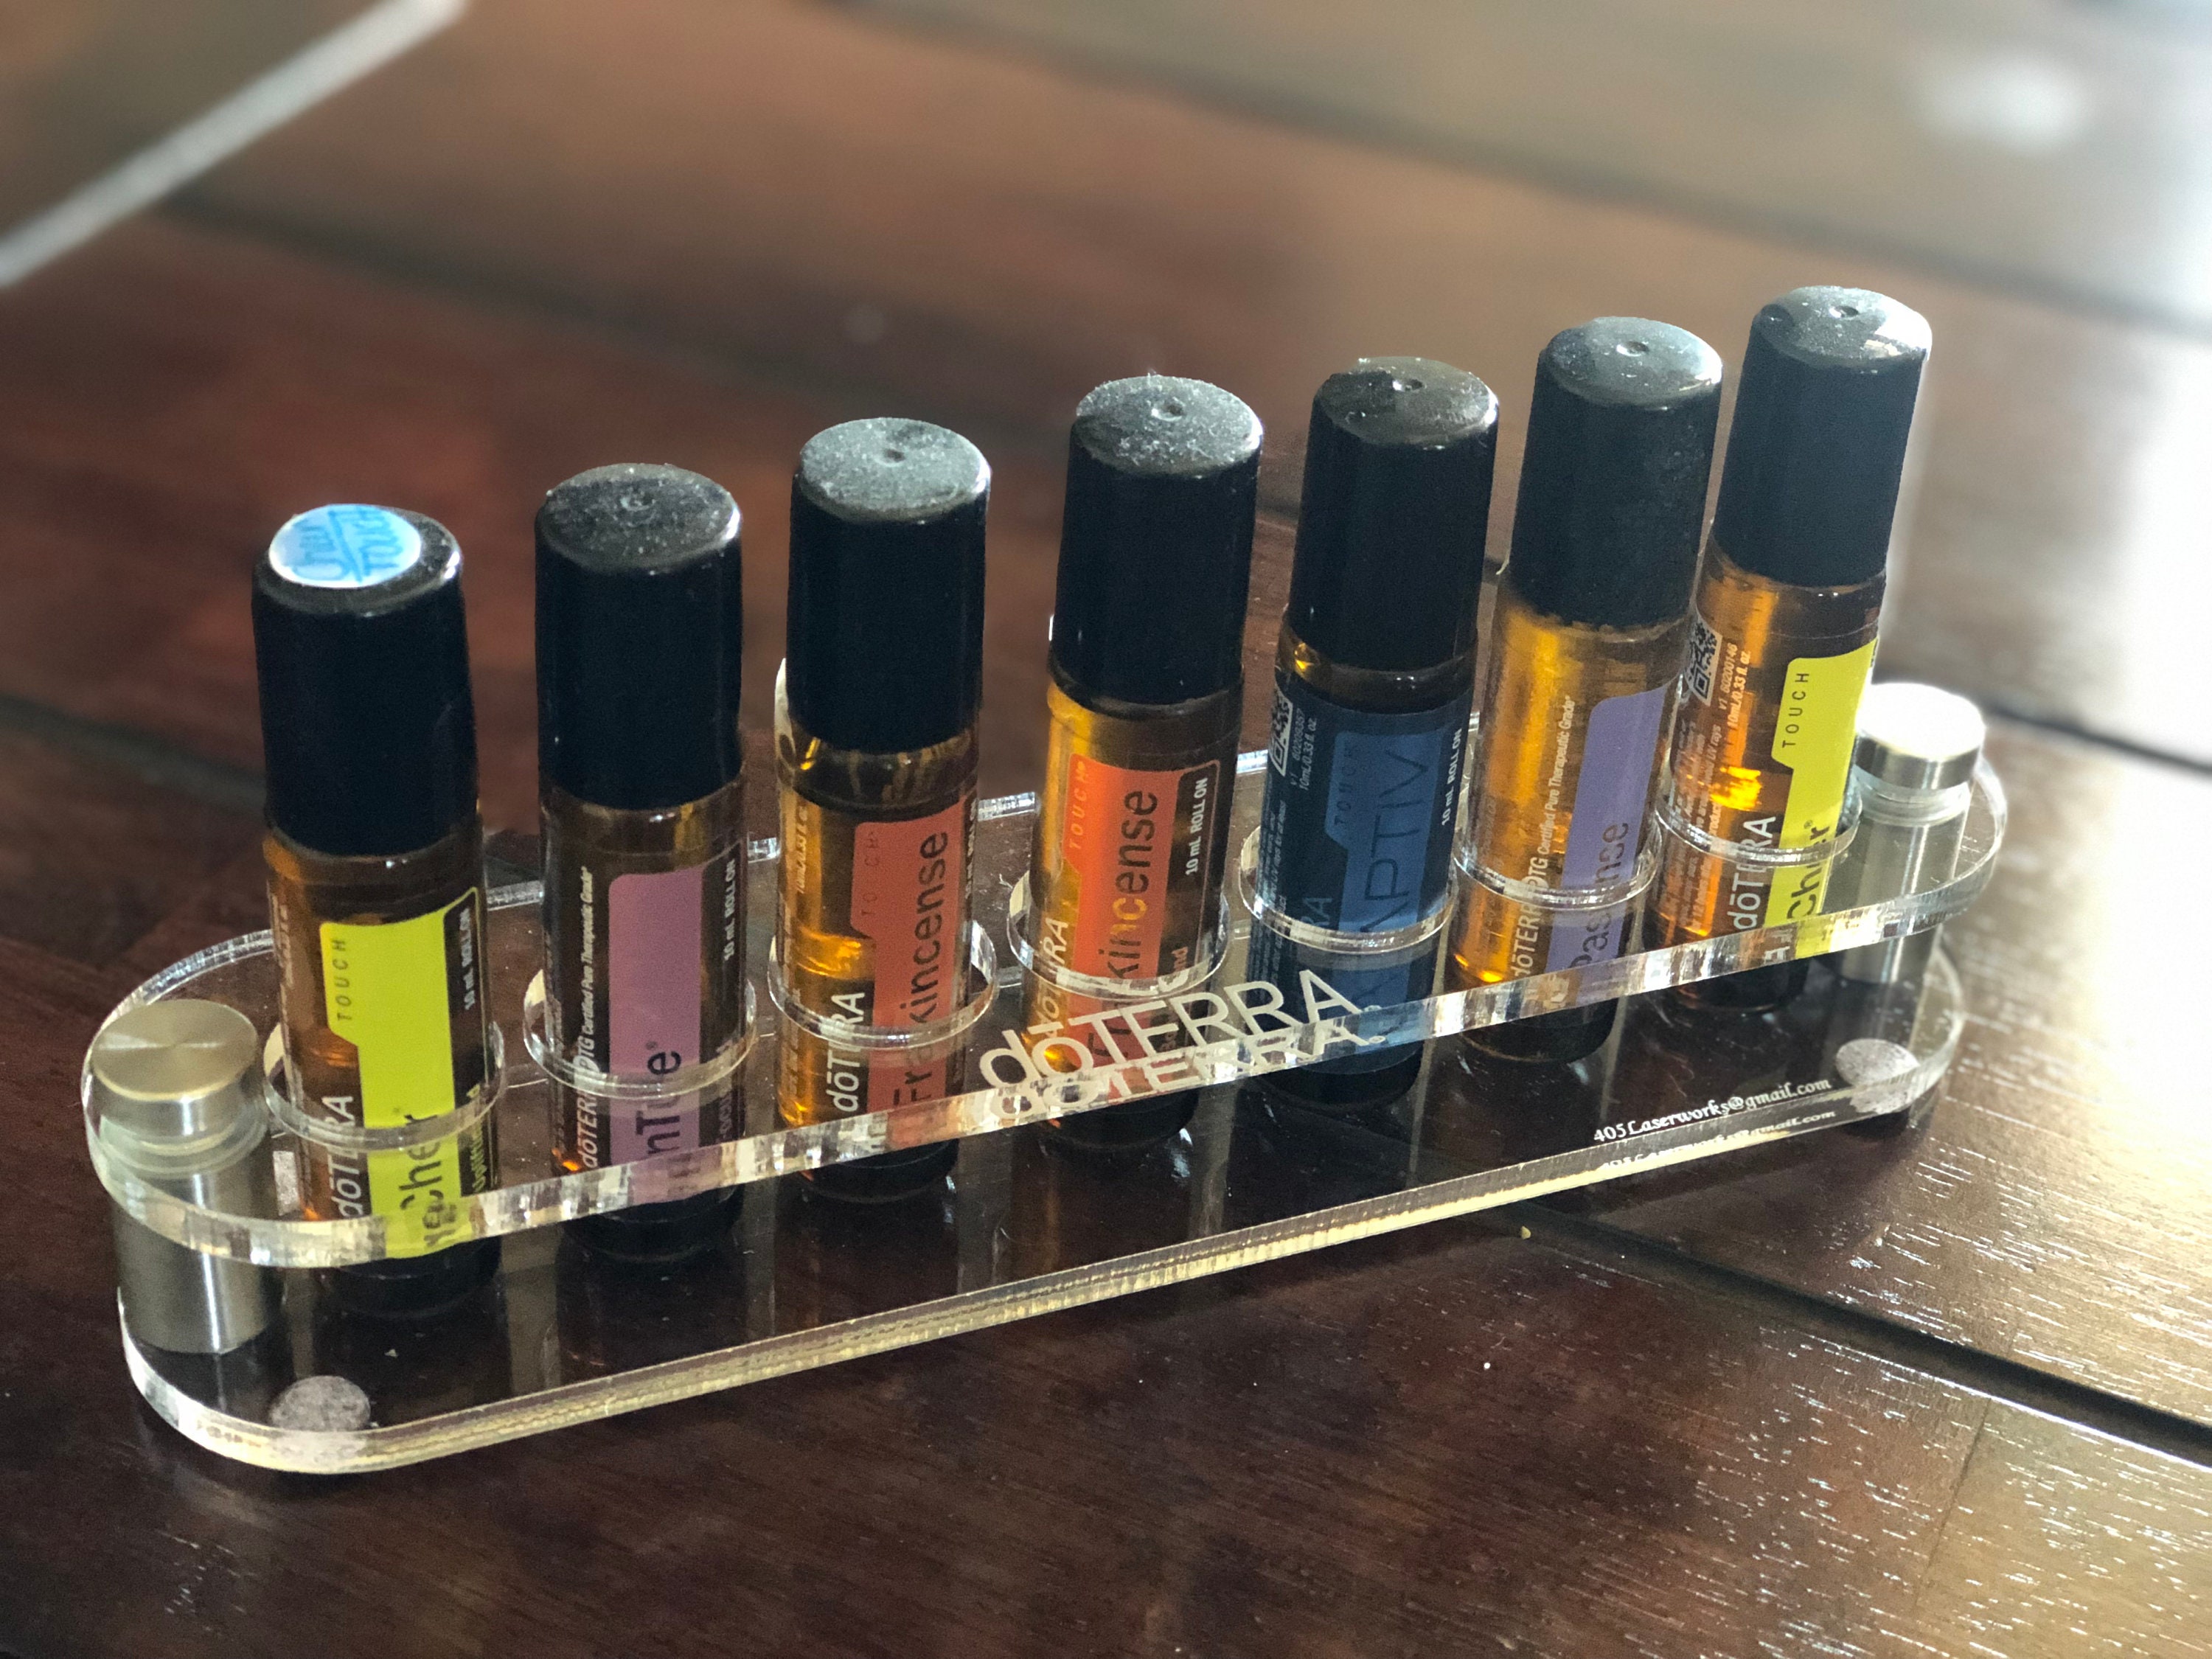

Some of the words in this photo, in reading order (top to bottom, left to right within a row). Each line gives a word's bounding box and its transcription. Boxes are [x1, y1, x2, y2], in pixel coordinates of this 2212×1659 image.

[1720, 642, 1739, 694] 60200146
[1726, 677, 1747, 728] 10mL/0.33
[1782, 672, 1809, 748] TOUCH
[1452, 728, 1462, 750] ON
[1446, 750, 1460, 785] ROLL
[1548, 731, 1571, 787] Therapeutic
[1194, 777, 1208, 799] ON
[1444, 786, 1455, 807] mL
[1544, 789, 1560, 812] Pure
[1069, 774, 1089, 850] TOUCH
[1189, 799, 1206, 832] ROLL
[1441, 807, 1452, 826] 10
[1188, 836, 1202, 857] mL
[1536, 813, 1557, 855] Certified
[1186, 858, 1200, 875] 10
[331, 938, 352, 1022] TOUCH
